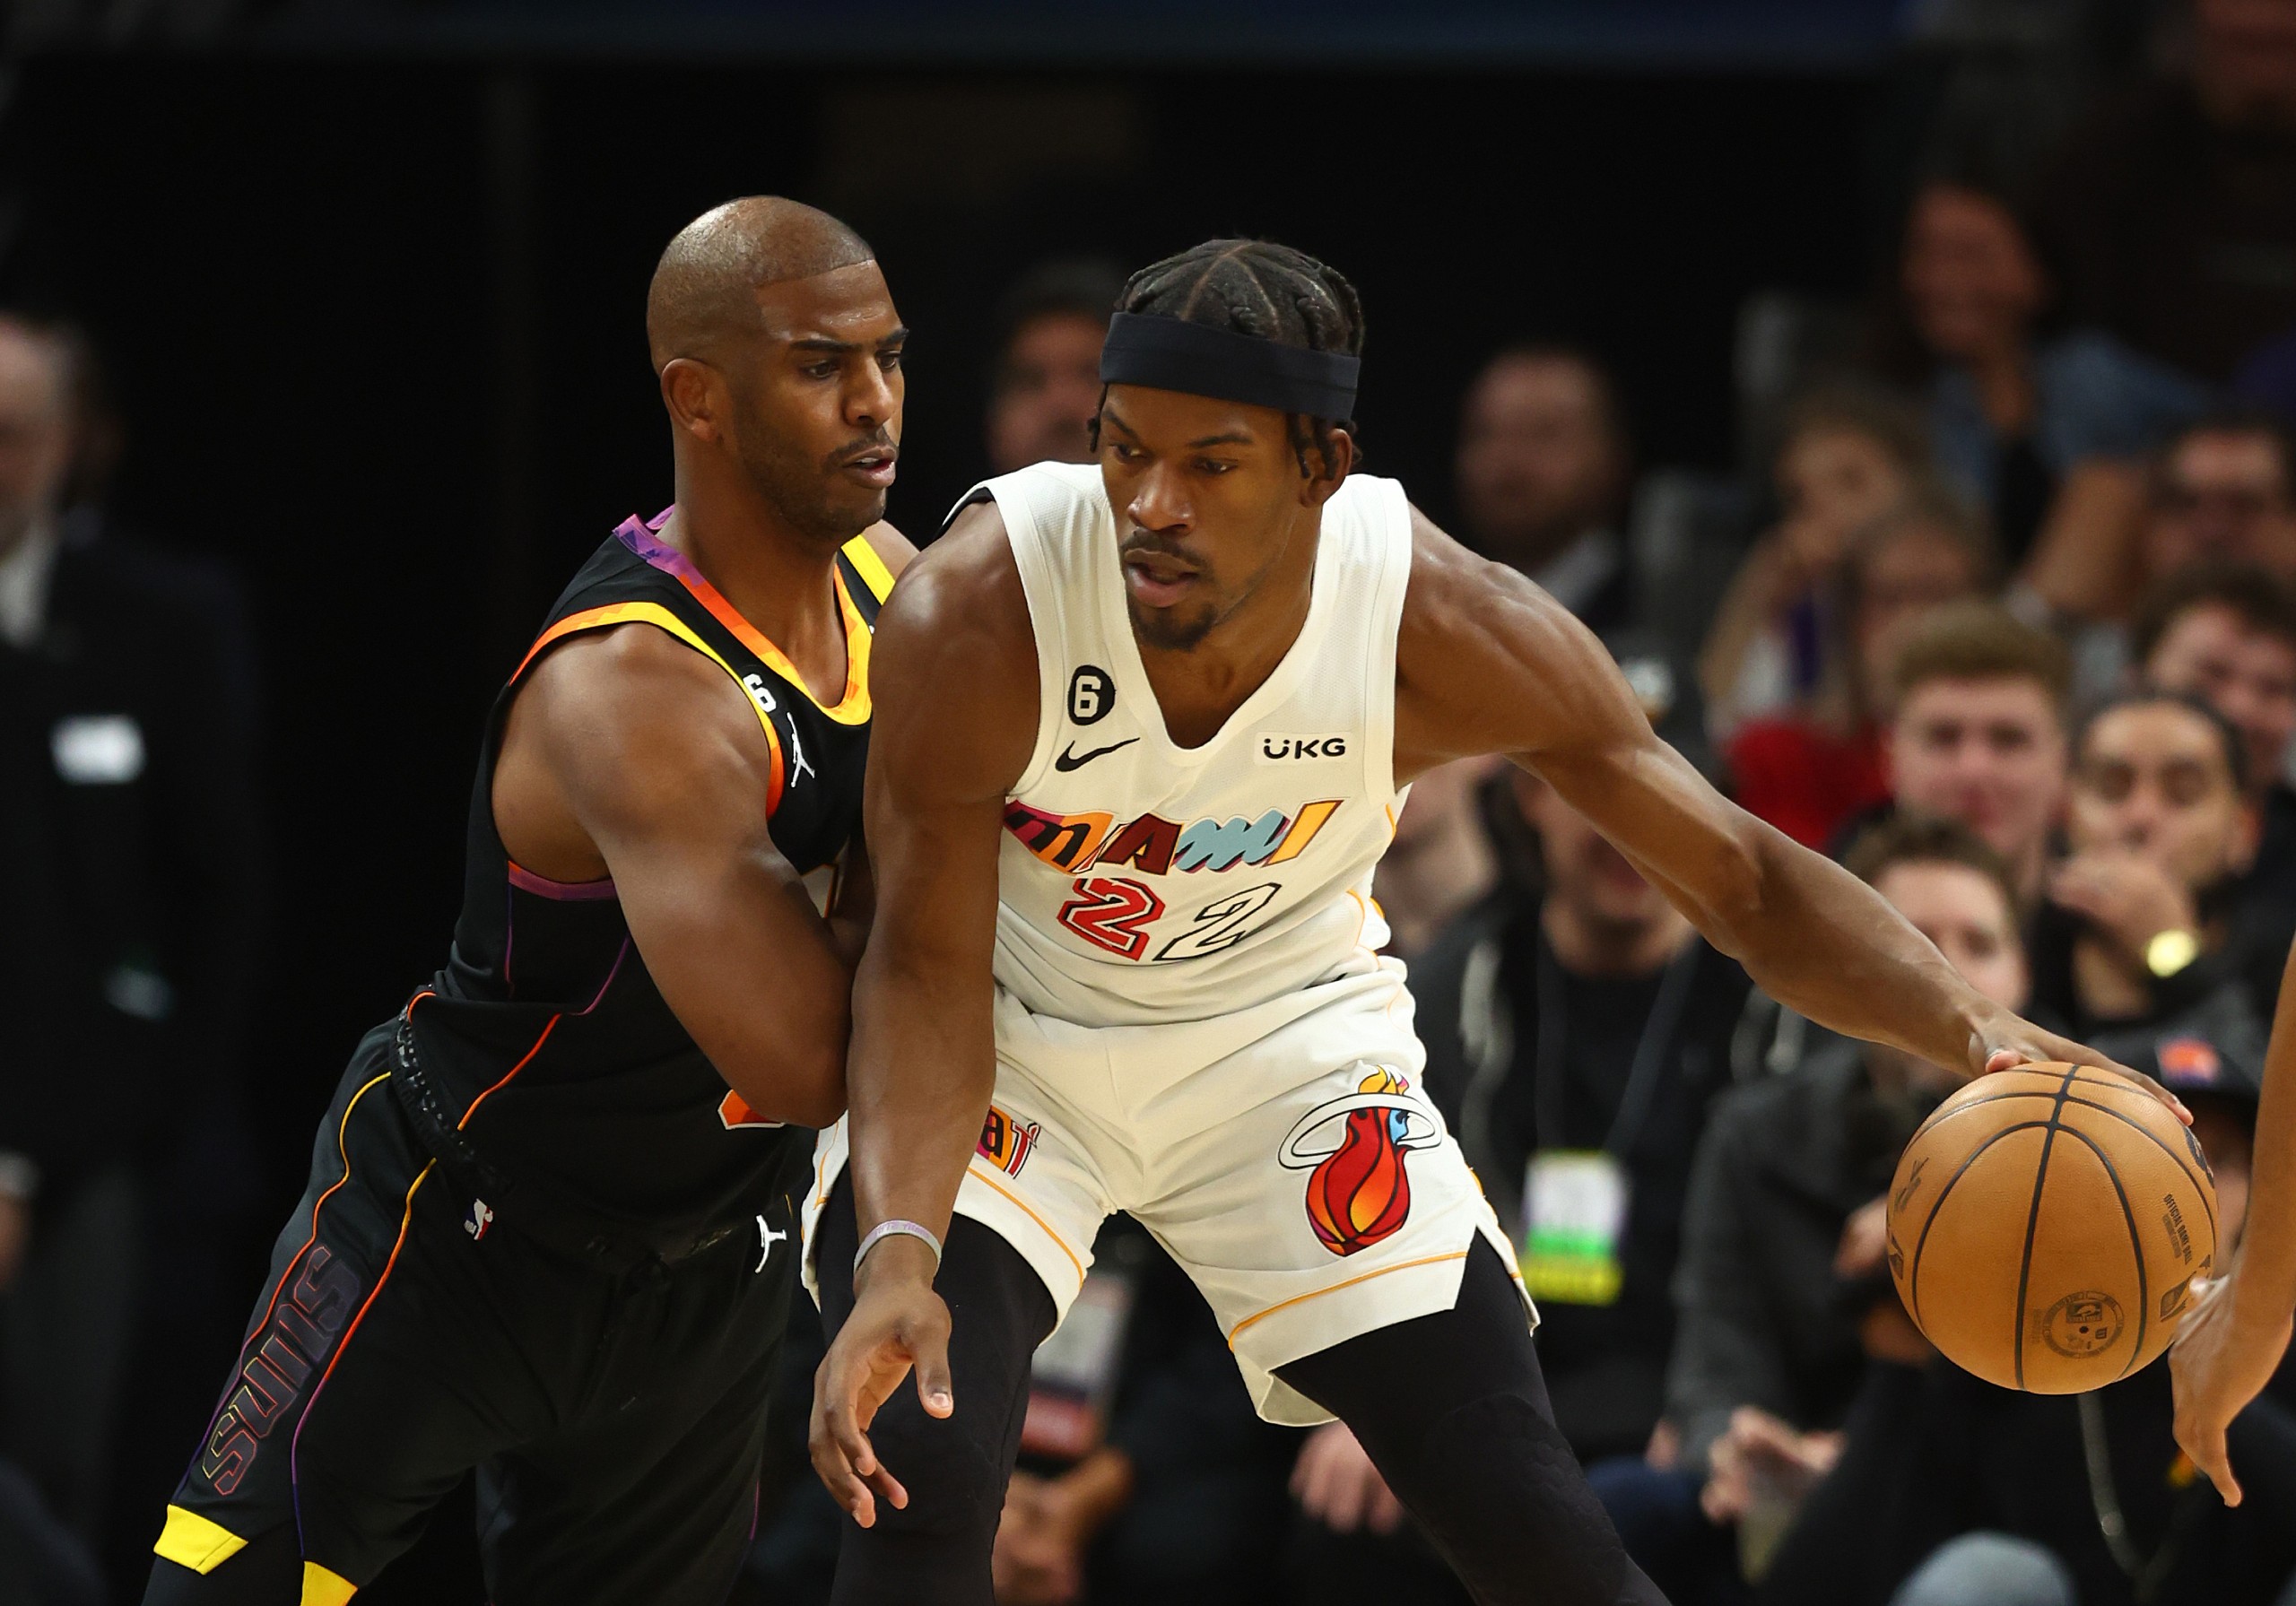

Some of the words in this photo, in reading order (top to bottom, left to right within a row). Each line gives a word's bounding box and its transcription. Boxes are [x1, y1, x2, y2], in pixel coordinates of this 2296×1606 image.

[744, 673, 776, 712] 6
[1074, 675, 1101, 718] 6
[1057, 878, 1282, 961] 22
